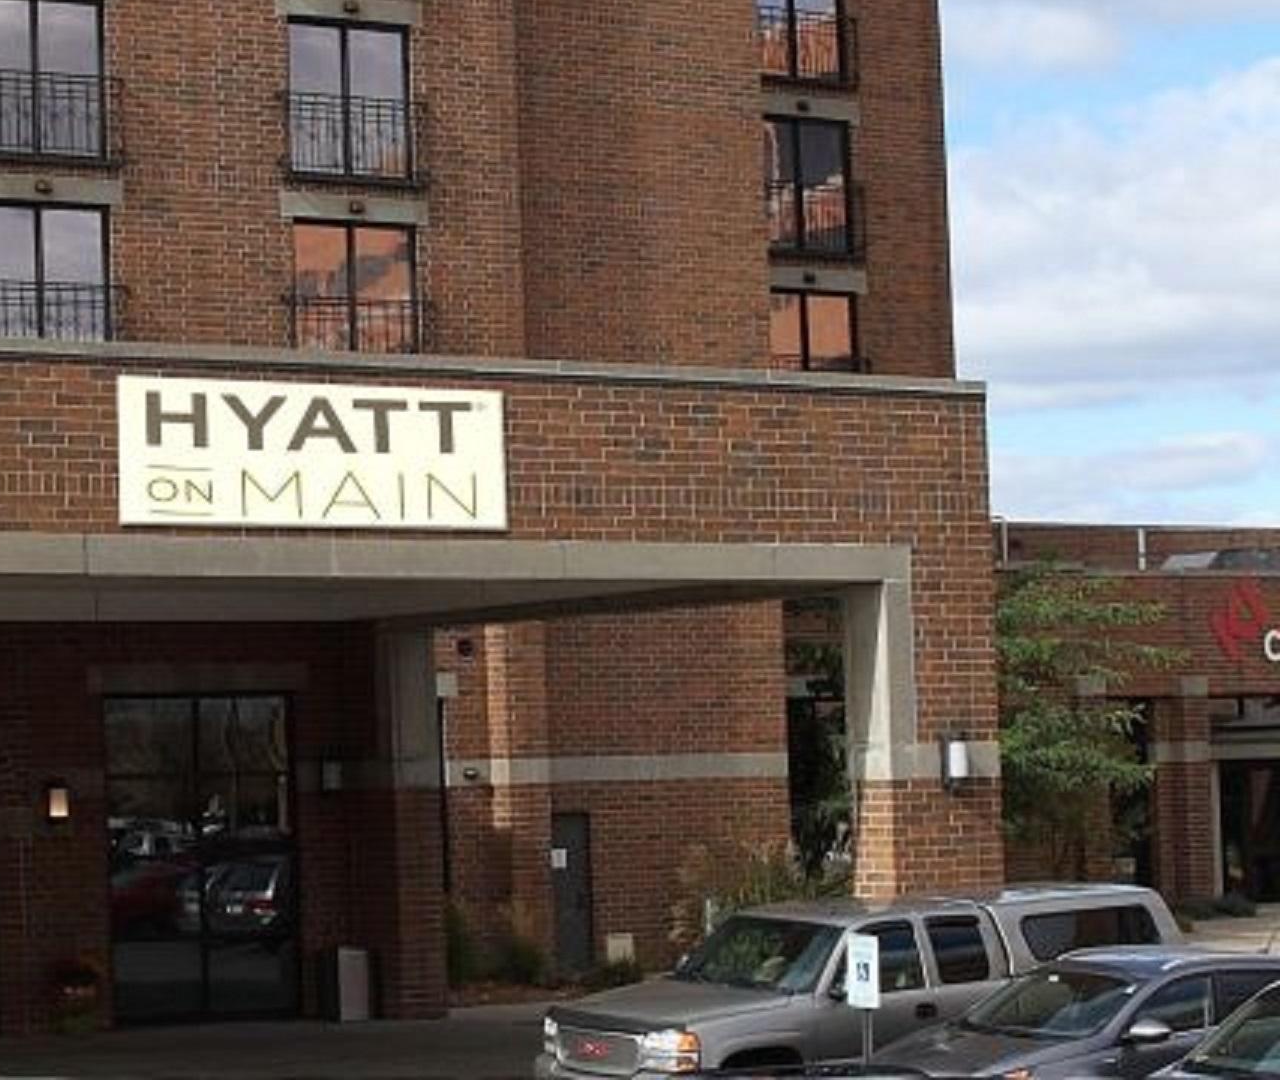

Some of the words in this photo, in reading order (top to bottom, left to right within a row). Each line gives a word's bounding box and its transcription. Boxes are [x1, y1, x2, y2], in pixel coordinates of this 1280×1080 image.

[144, 390, 473, 454] HYATT
[146, 476, 214, 505] ON
[240, 468, 478, 520] MAIN
